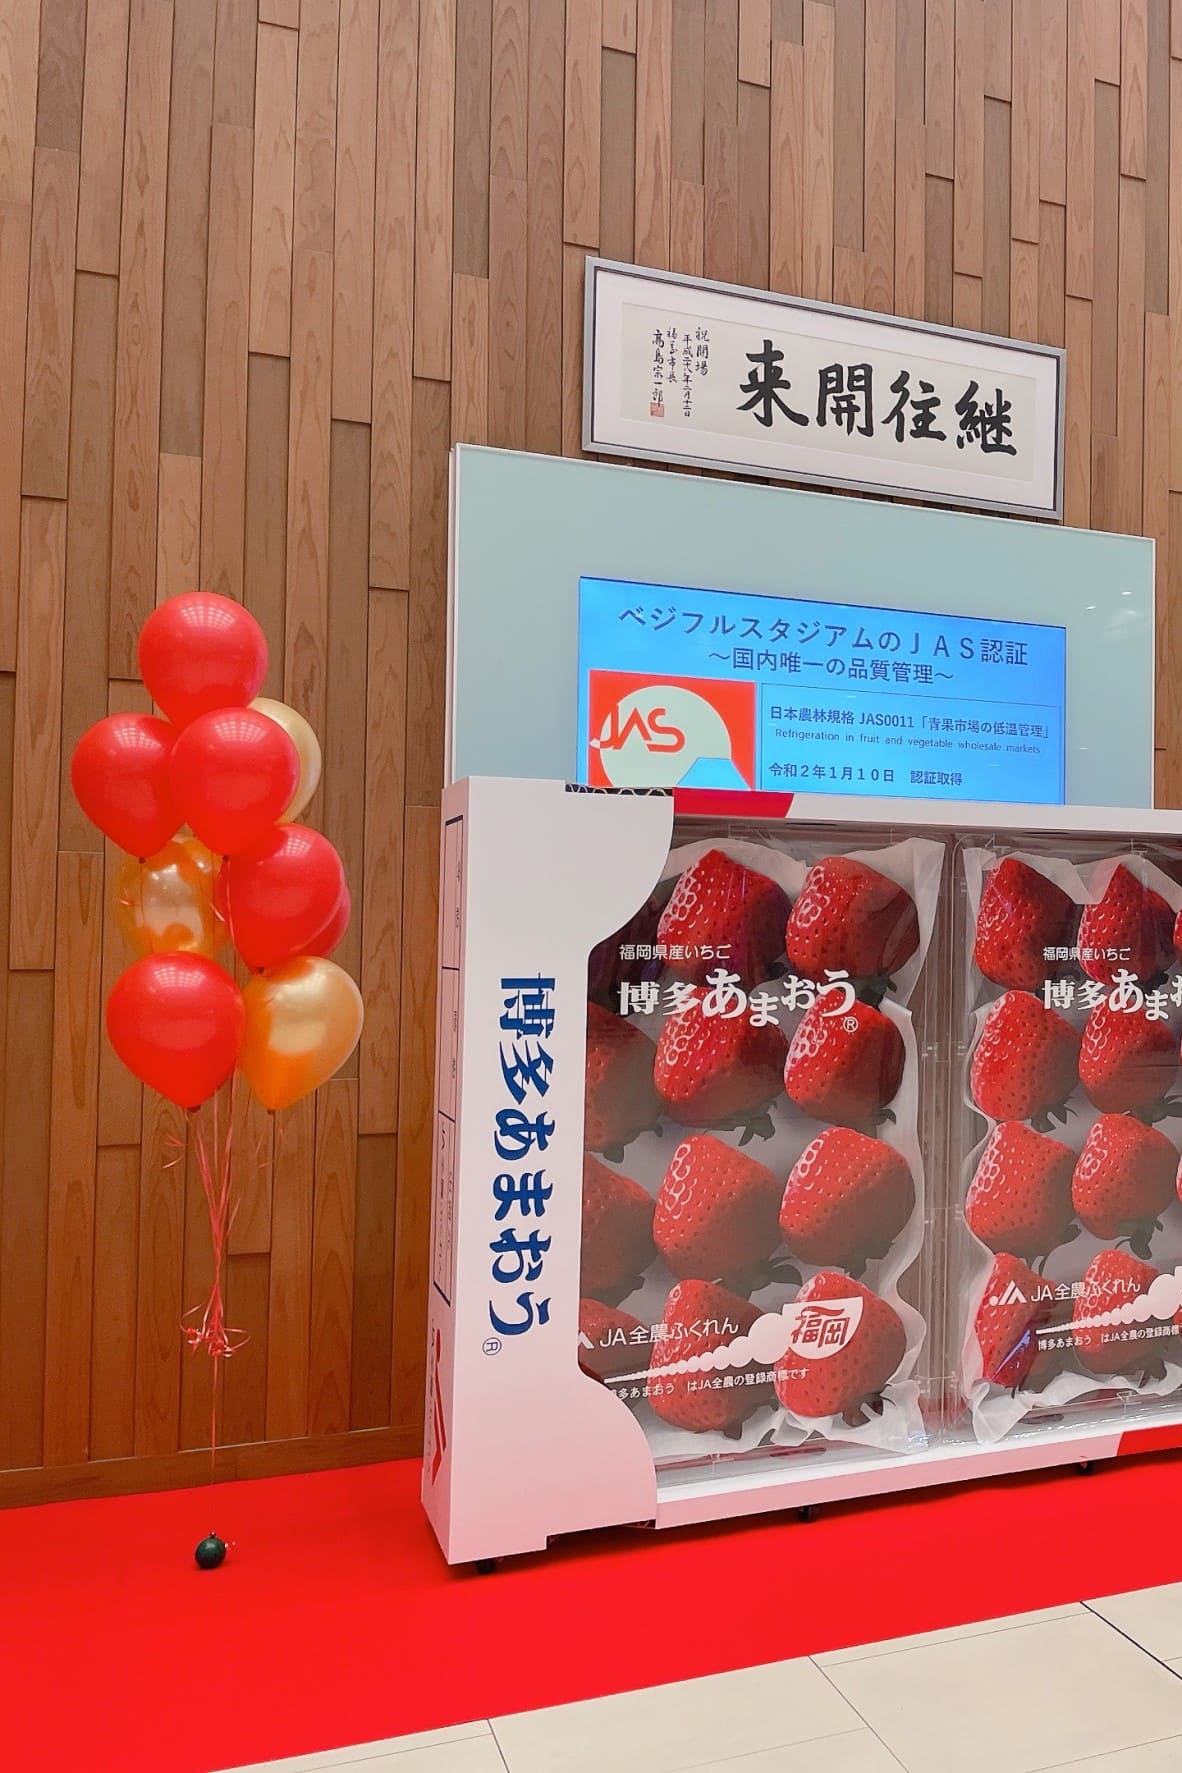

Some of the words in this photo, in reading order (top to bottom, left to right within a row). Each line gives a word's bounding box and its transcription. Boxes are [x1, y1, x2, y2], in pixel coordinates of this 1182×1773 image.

[769, 705, 855, 725] 日本農林規格
[589, 702, 686, 753] JAS
[775, 728, 840, 742] Refrigeration
[845, 734, 855, 742] in
[860, 733, 880, 744] fruit
[885, 736, 903, 745] and
[907, 737, 953, 749] vegetable
[958, 740, 1002, 751] wholesale
[1006, 744, 1041, 754] markets
[910, 770, 963, 786] 認証取得
[619, 943, 732, 961] 福岡県産いちご
[1043, 946, 1131, 962] 福岡県産いちご
[617, 967, 857, 1029] 博多あまおう
[489, 972, 556, 1336] 博多あまおう
[1031, 1278, 1142, 1302] JA全農ふくれん
[600, 1317, 739, 1349] JA全農ふくれん
[789, 1305, 851, 1350] 福岡
[1038, 1336, 1092, 1351] 博多あまおう
[611, 1382, 675, 1401] 多あまおう
